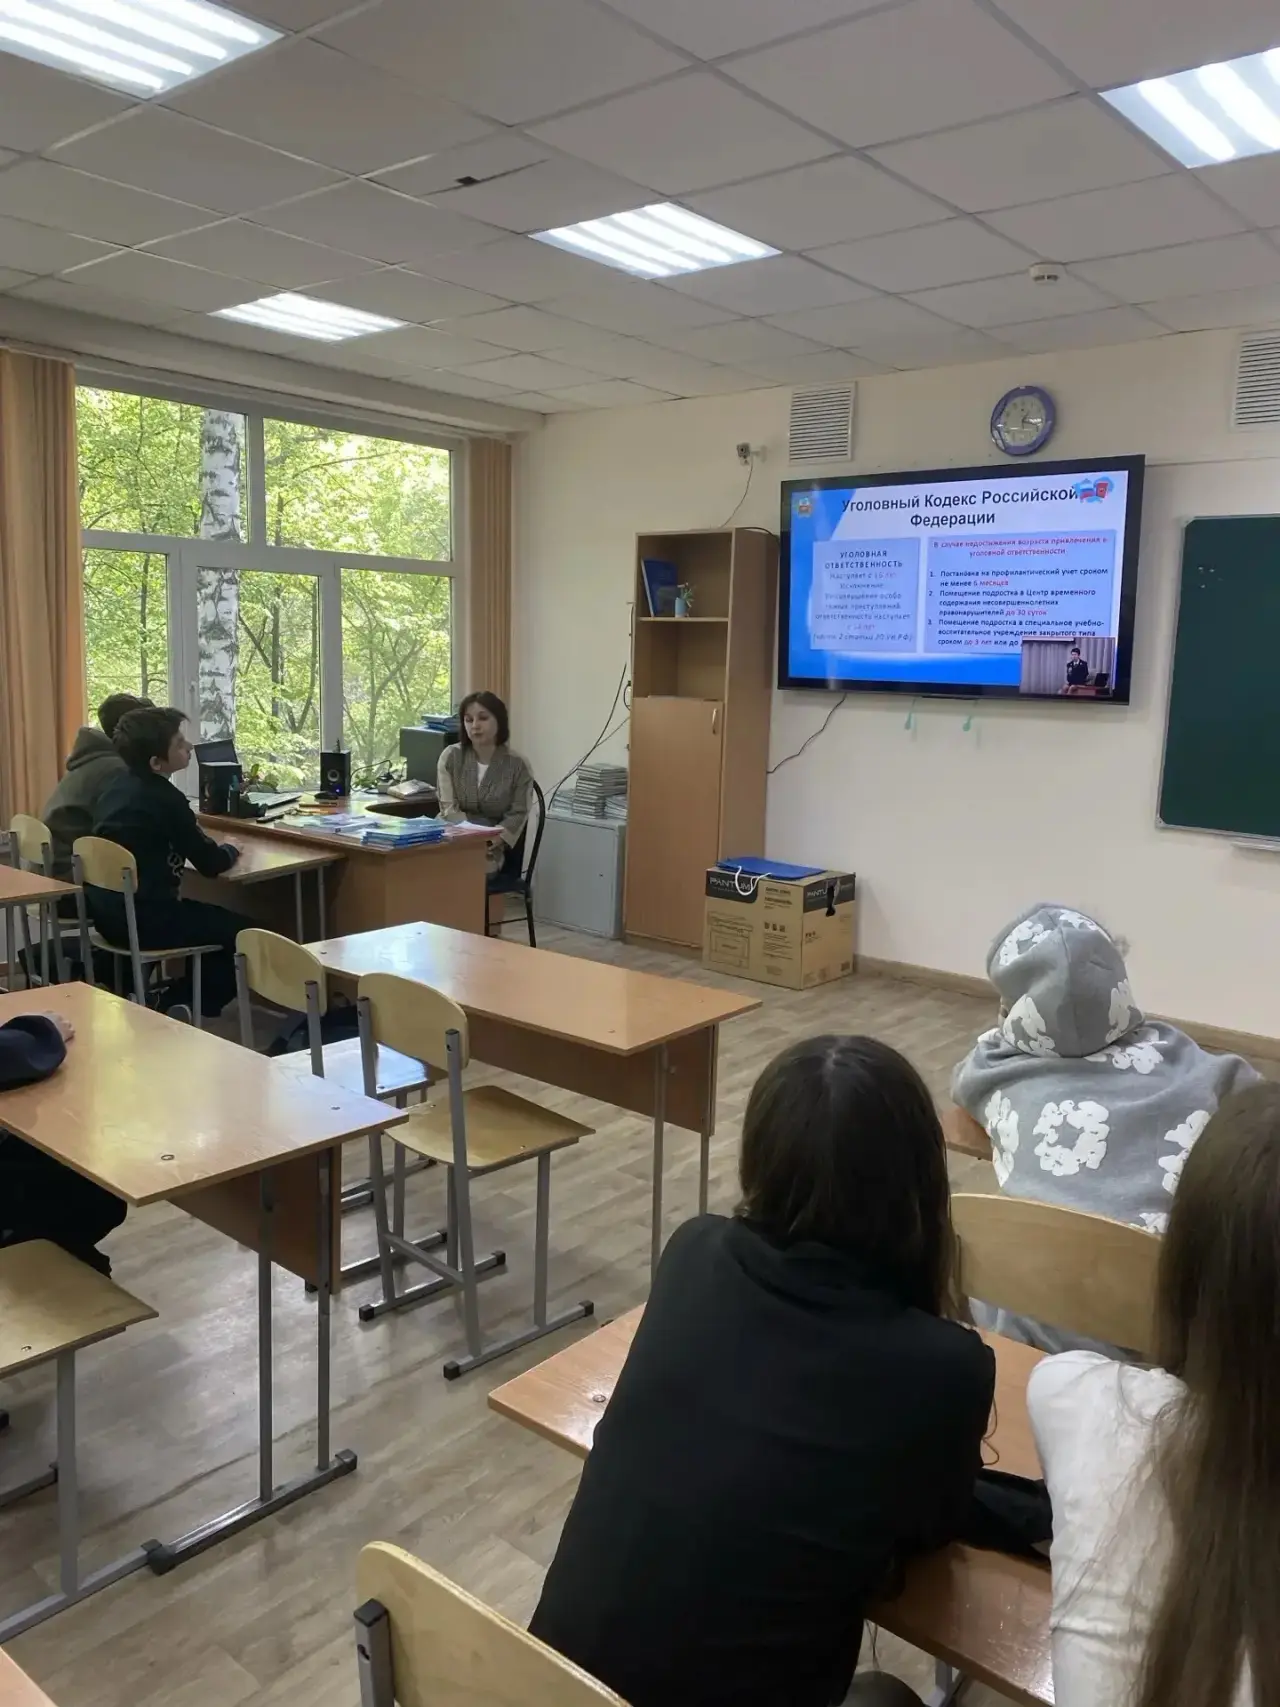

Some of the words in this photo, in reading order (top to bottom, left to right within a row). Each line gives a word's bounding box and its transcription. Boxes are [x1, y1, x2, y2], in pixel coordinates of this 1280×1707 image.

[842, 495, 920, 512] Уголовный
[924, 494, 977, 508] Кодекс
[982, 486, 1078, 505] Российской
[910, 512, 996, 528] Федерации
[1051, 537, 1100, 545] привлечения
[840, 550, 887, 558] УГОЛОВНАЯ
[969, 549, 1005, 558] уголовной
[1007, 548, 1065, 556] ответственности
[825, 561, 902, 569] ОТВЕТСТВЕННОСТЬ
[980, 579, 1009, 587] месяцев
[1026, 589, 1048, 597] Центр
[939, 599, 981, 607] содержания
[983, 599, 1058, 607] несовершеннолетних
[939, 609, 1004, 617] правонарушителей
[981, 619, 1017, 627] подростка
[993, 629, 1037, 637] учреждение
[710, 877, 750, 890] PANTUM
